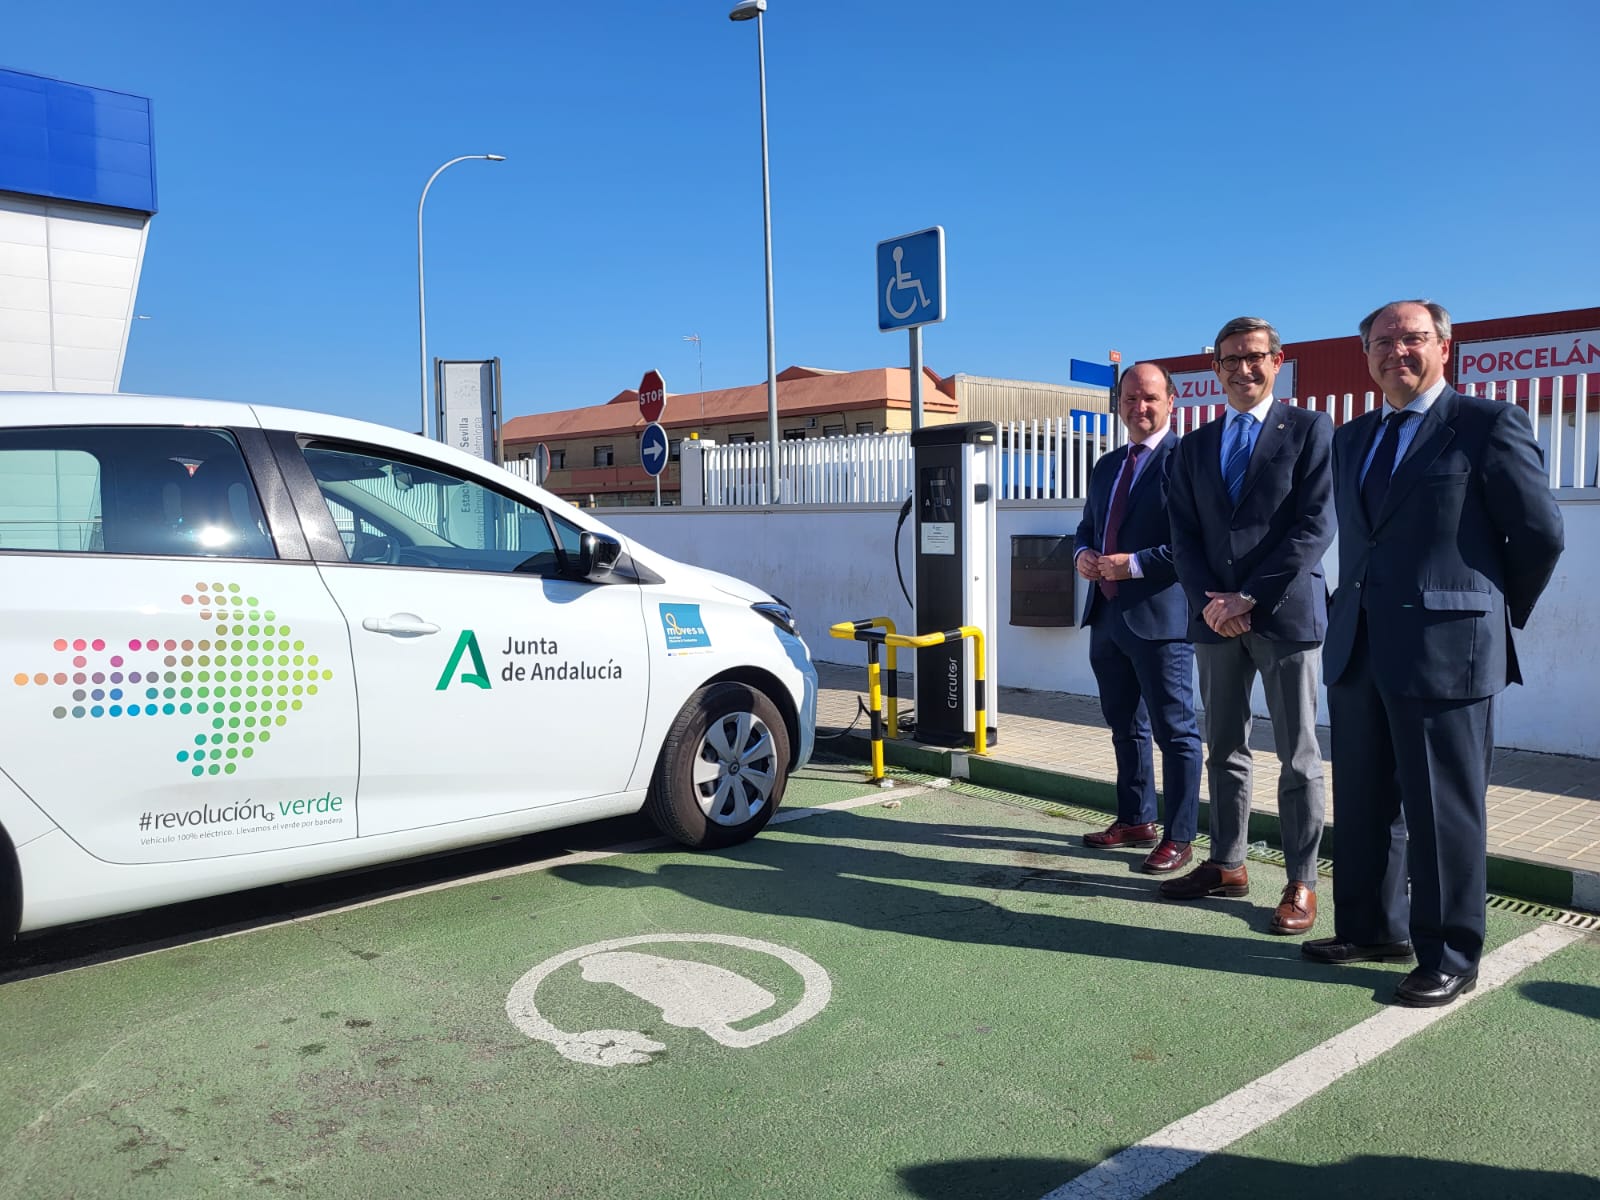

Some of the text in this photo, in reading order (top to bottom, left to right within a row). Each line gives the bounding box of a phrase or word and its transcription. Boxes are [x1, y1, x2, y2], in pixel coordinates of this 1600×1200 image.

[640, 389, 663, 405] STOP
[459, 417, 469, 448] Sevilla
[502, 636, 558, 655] Junta
[501, 658, 622, 681] de Andalucía
[948, 656, 958, 709] Circutor
[139, 792, 343, 831] #revolución verde
[177, 832, 199, 841] 100%
[236, 825, 271, 835] Llevamos
[272, 823, 279, 831] el
[280, 821, 301, 830] verde
[301, 820, 313, 829] por
[315, 817, 343, 826] bandera
